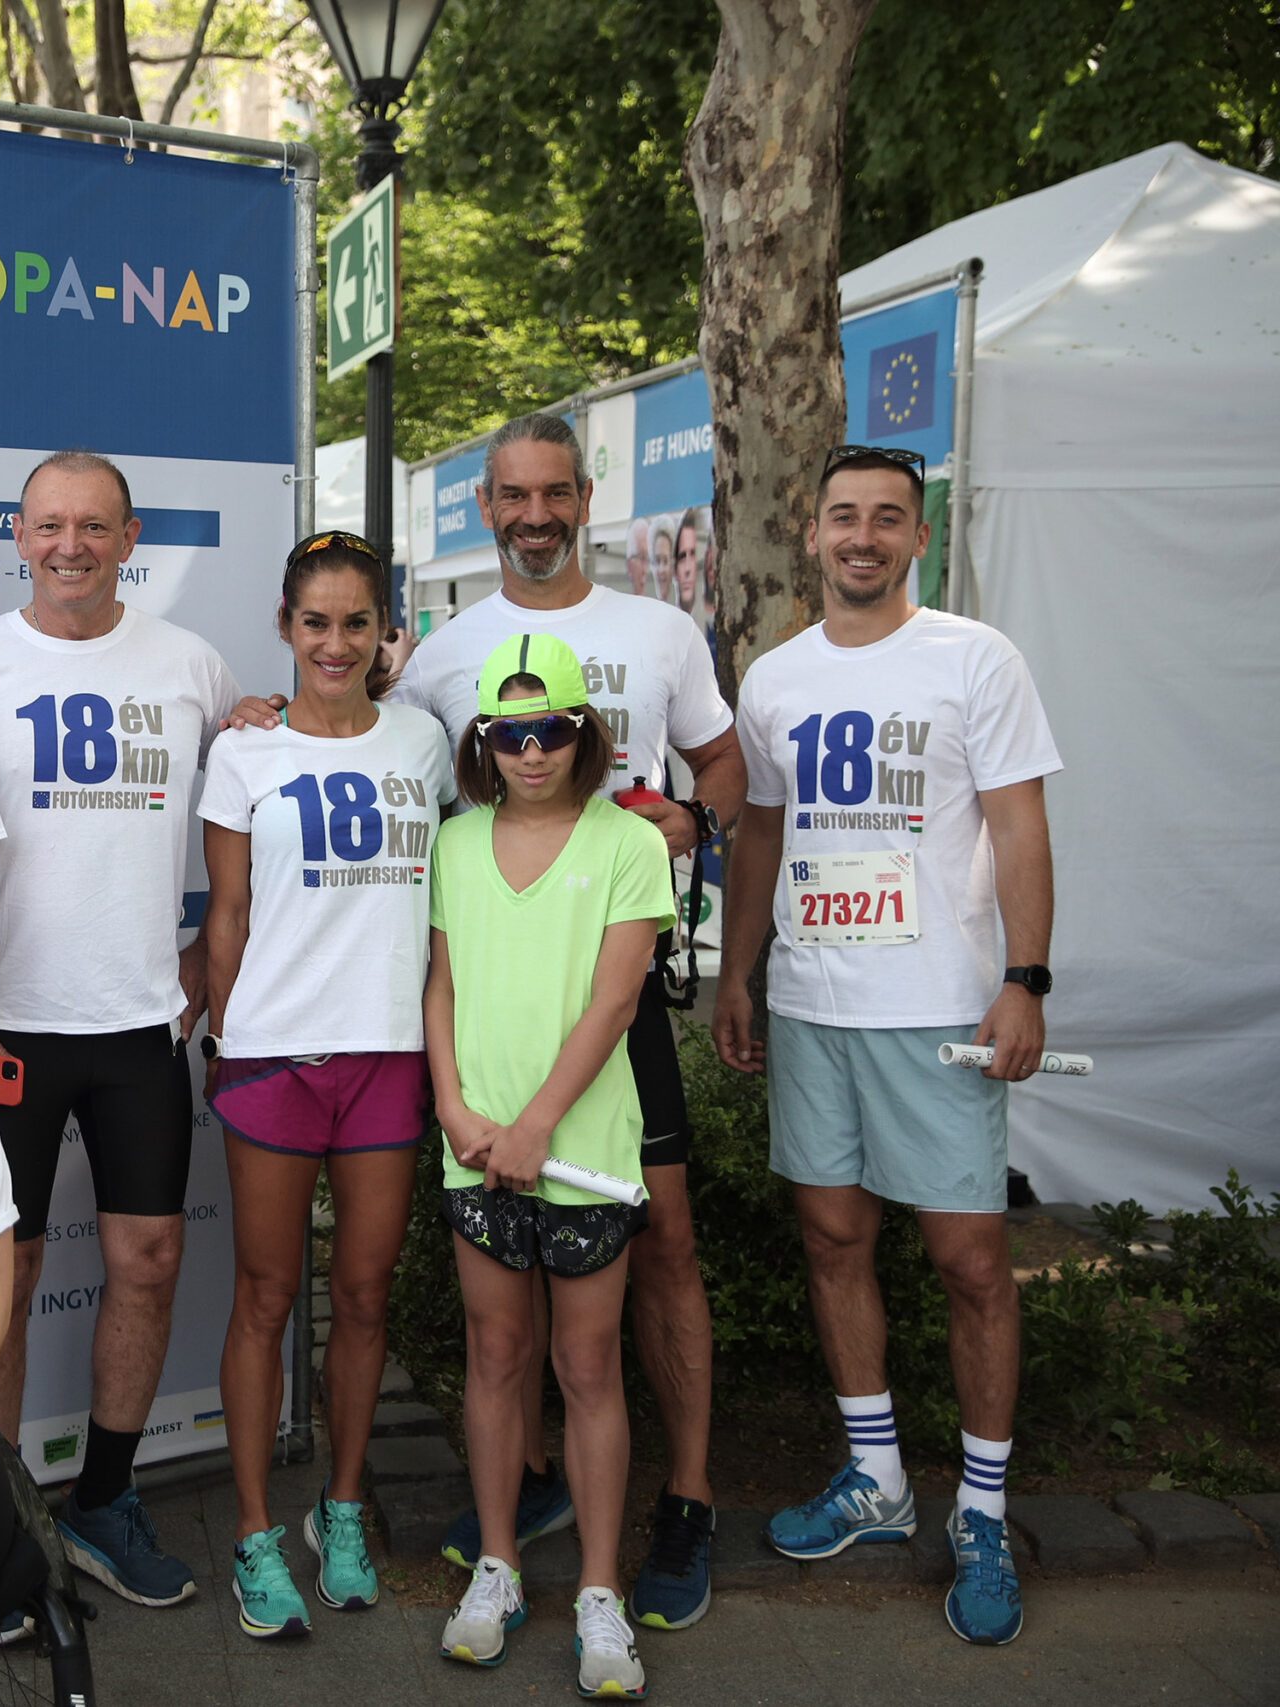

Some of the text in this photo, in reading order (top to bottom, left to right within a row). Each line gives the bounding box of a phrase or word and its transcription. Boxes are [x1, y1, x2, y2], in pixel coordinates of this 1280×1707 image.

[643, 436, 665, 467] JEF
[581, 656, 627, 695] év
[16, 692, 163, 785] 18 év
[788, 710, 931, 806] 18 év
[121, 740, 169, 784] km
[52, 787, 149, 810] FUTÓVERSENY
[878, 761, 925, 807] km
[279, 771, 427, 862] 18 év
[812, 808, 908, 831] FUTÓVERSENY
[387, 814, 430, 859] km
[322, 864, 414, 888] FUTÓVERSENY
[789, 860, 810, 882] 18
[800, 890, 904, 926] 2732/1
